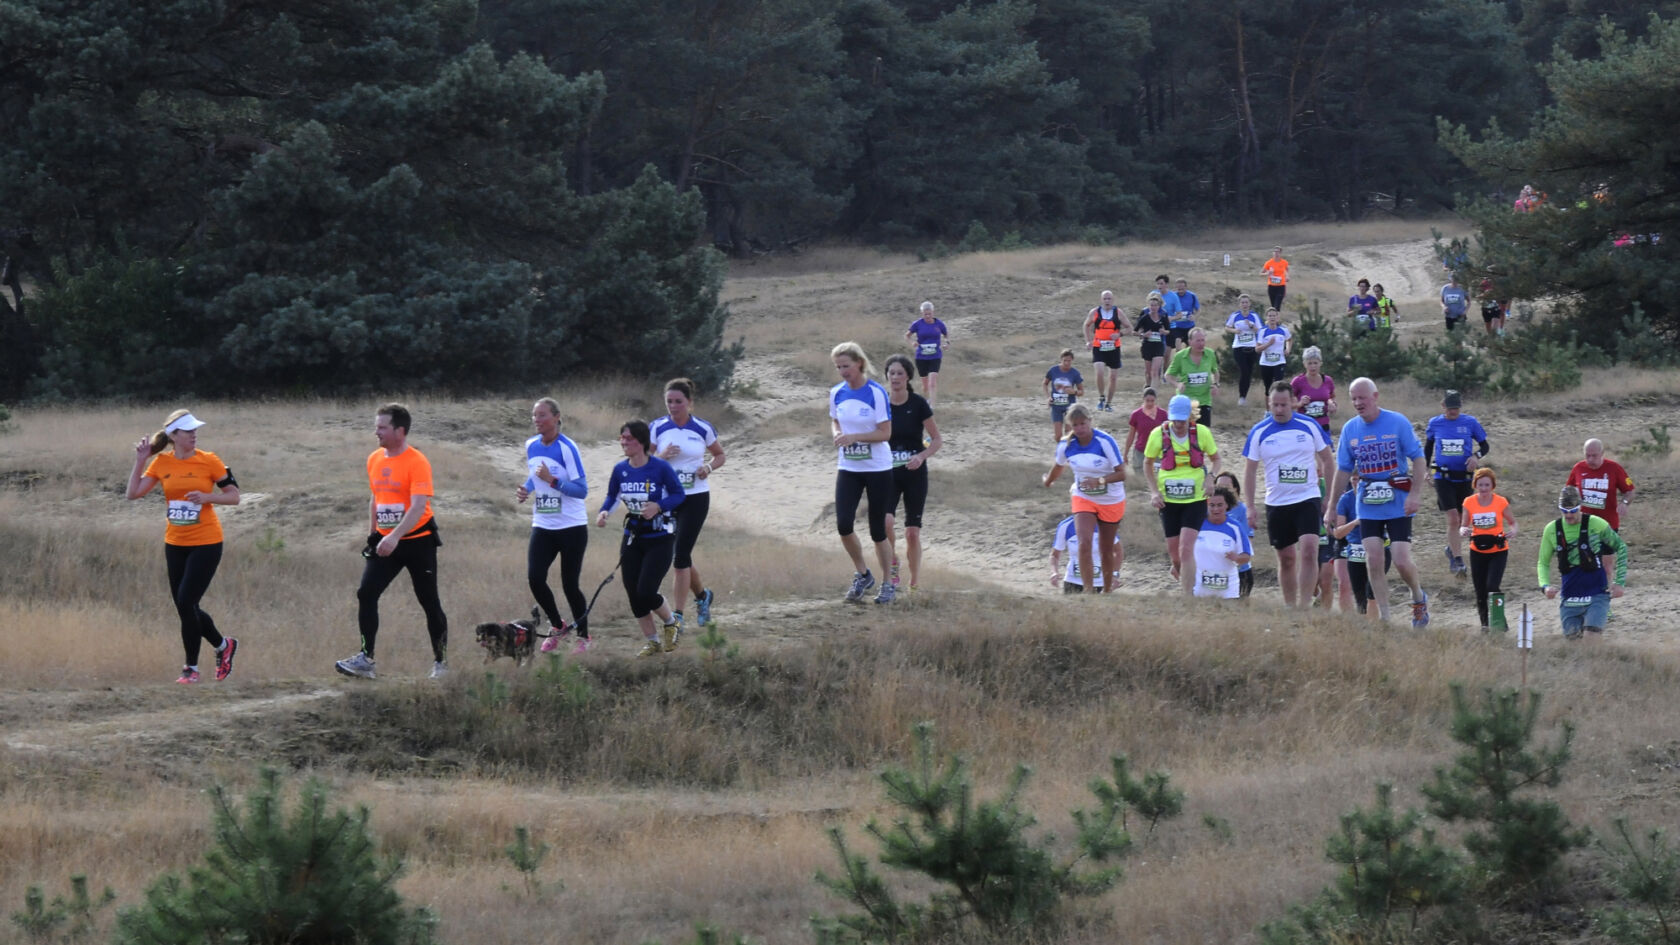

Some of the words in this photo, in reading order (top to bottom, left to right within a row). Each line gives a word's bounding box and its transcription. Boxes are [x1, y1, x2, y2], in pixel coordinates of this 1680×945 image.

[1281, 470, 1307, 479] 3260
[1367, 488, 1394, 500] 2909
[169, 508, 199, 521] 2812
[377, 511, 403, 523] 3087
[1203, 576, 1228, 587] 3157
